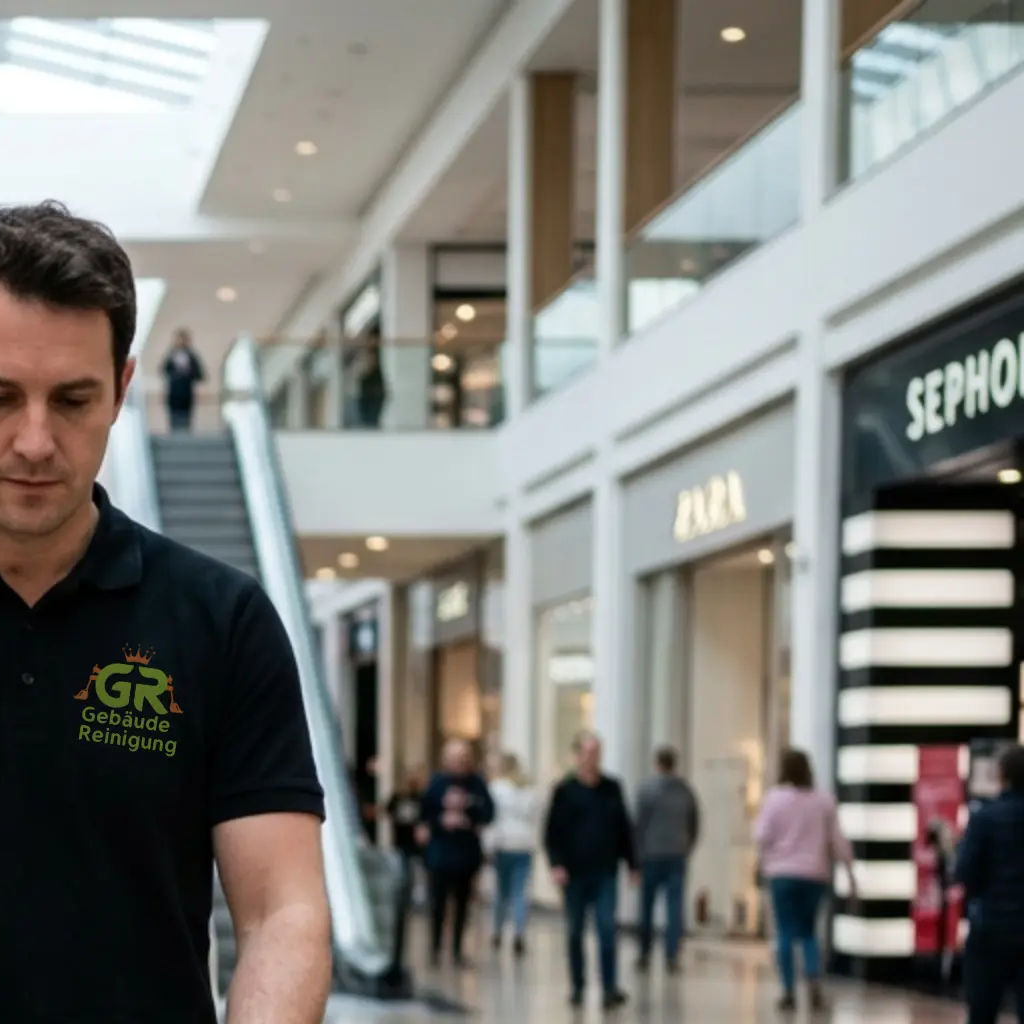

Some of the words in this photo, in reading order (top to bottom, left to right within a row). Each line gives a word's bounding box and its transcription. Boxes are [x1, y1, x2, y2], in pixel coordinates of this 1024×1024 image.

[906, 331, 1024, 441] SEPHO
[95, 662, 169, 715] GR
[78, 724, 178, 757] Reinigung
[81, 706, 171, 733] Gebäude
